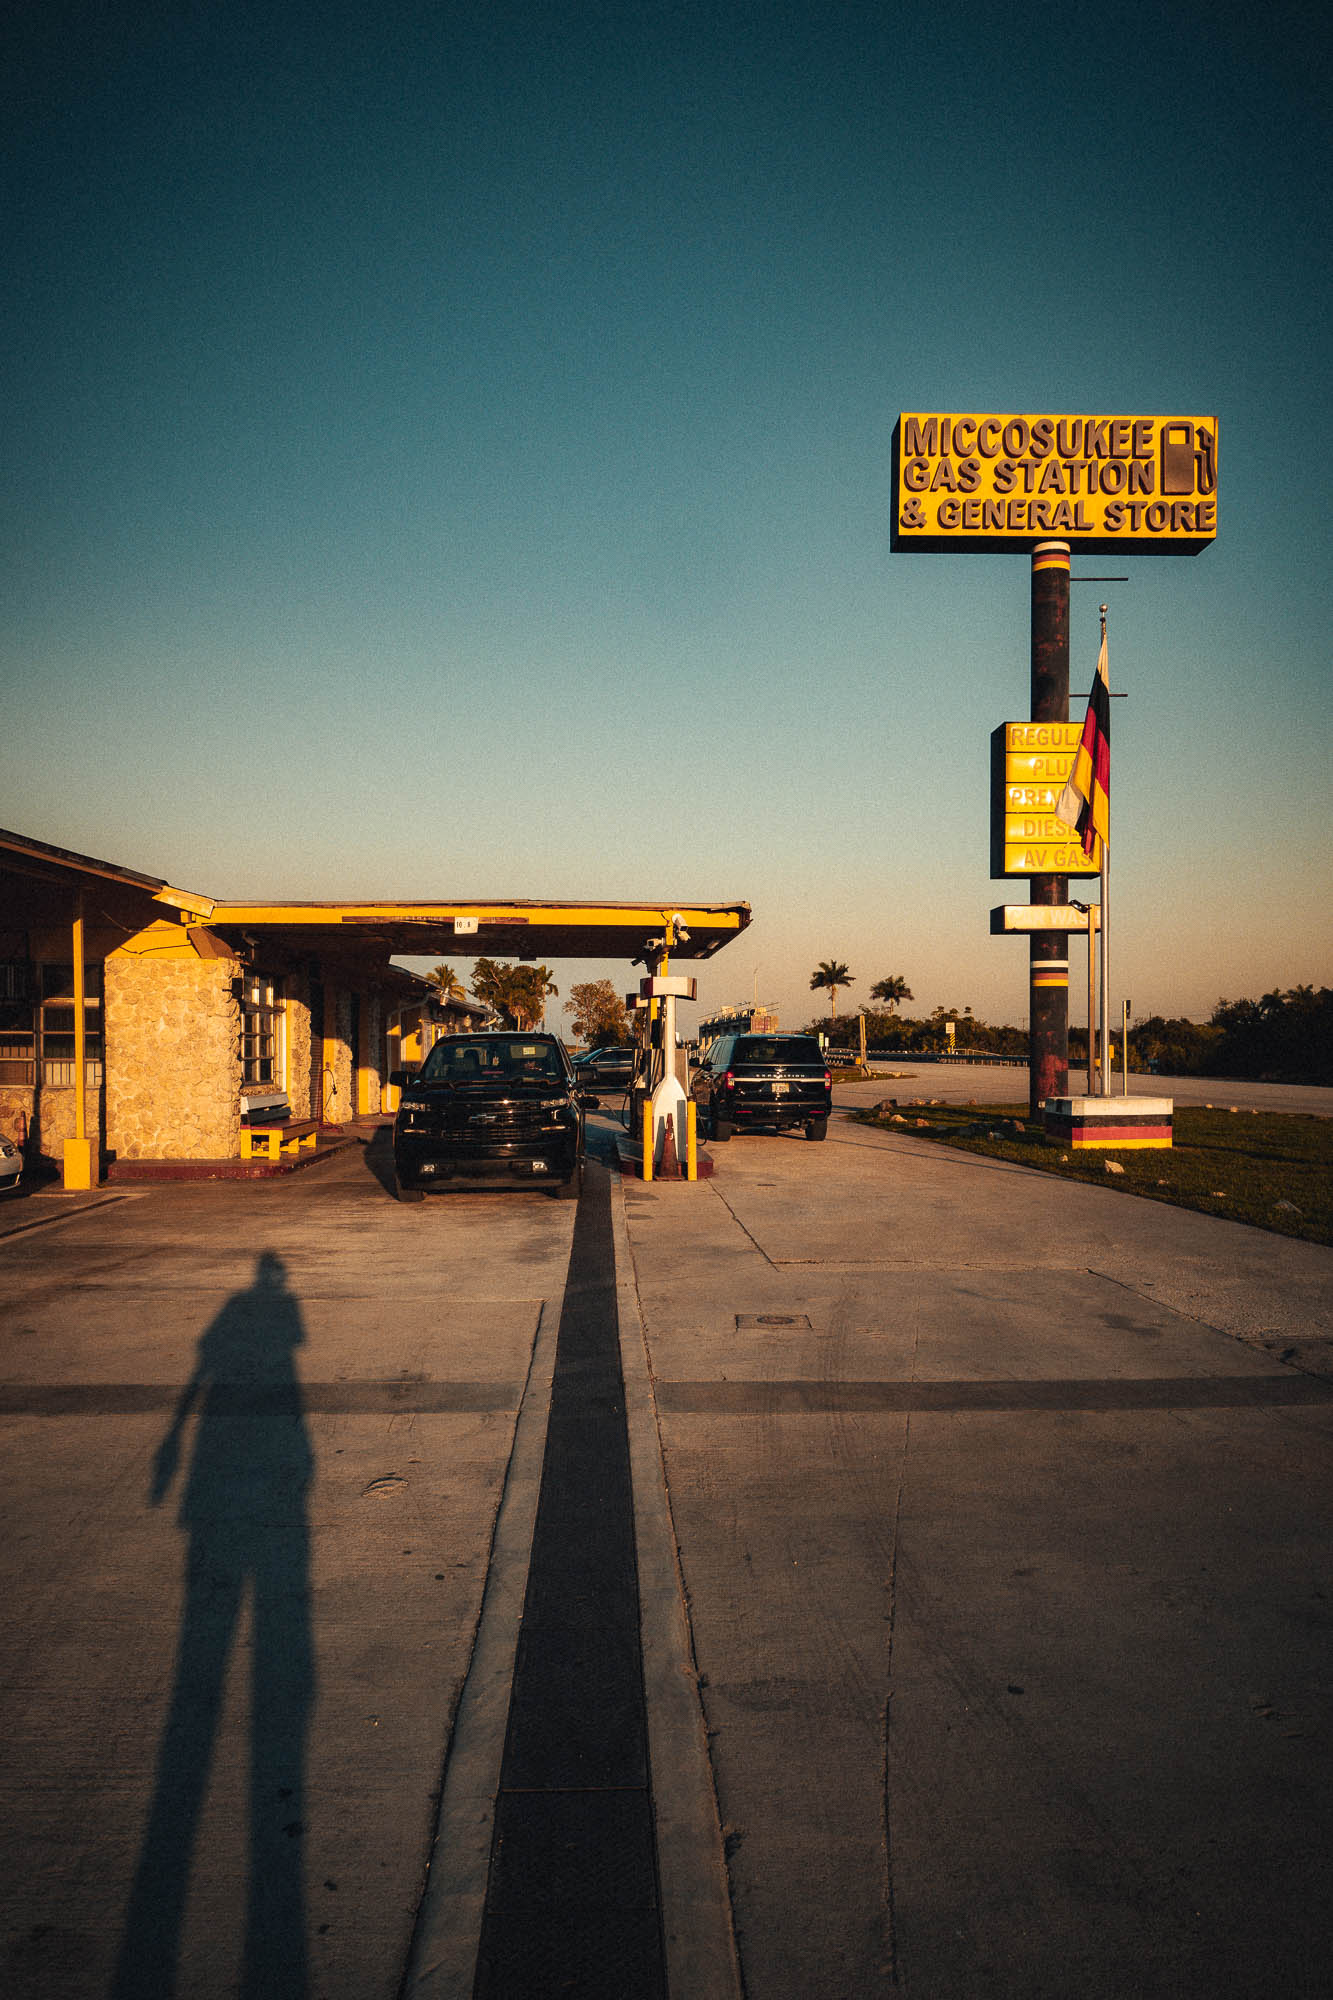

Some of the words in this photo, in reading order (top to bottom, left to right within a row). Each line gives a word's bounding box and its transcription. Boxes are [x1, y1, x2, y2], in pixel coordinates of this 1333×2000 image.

[905, 417, 1155, 460] MICCOSUKEE
[904, 457, 982, 492] GAS
[993, 458, 1155, 495] STATION
[900, 497, 927, 529] &
[937, 498, 1095, 531] GENERAL
[1103, 500, 1217, 532] STORE
[1011, 728, 1083, 746] REGUL
[1033, 759, 1074, 777] PLU
[1011, 789, 1064, 806] PREM
[1023, 819, 1081, 837] DIES
[1024, 850, 1047, 867] AV
[1054, 849, 1091, 867] GAS
